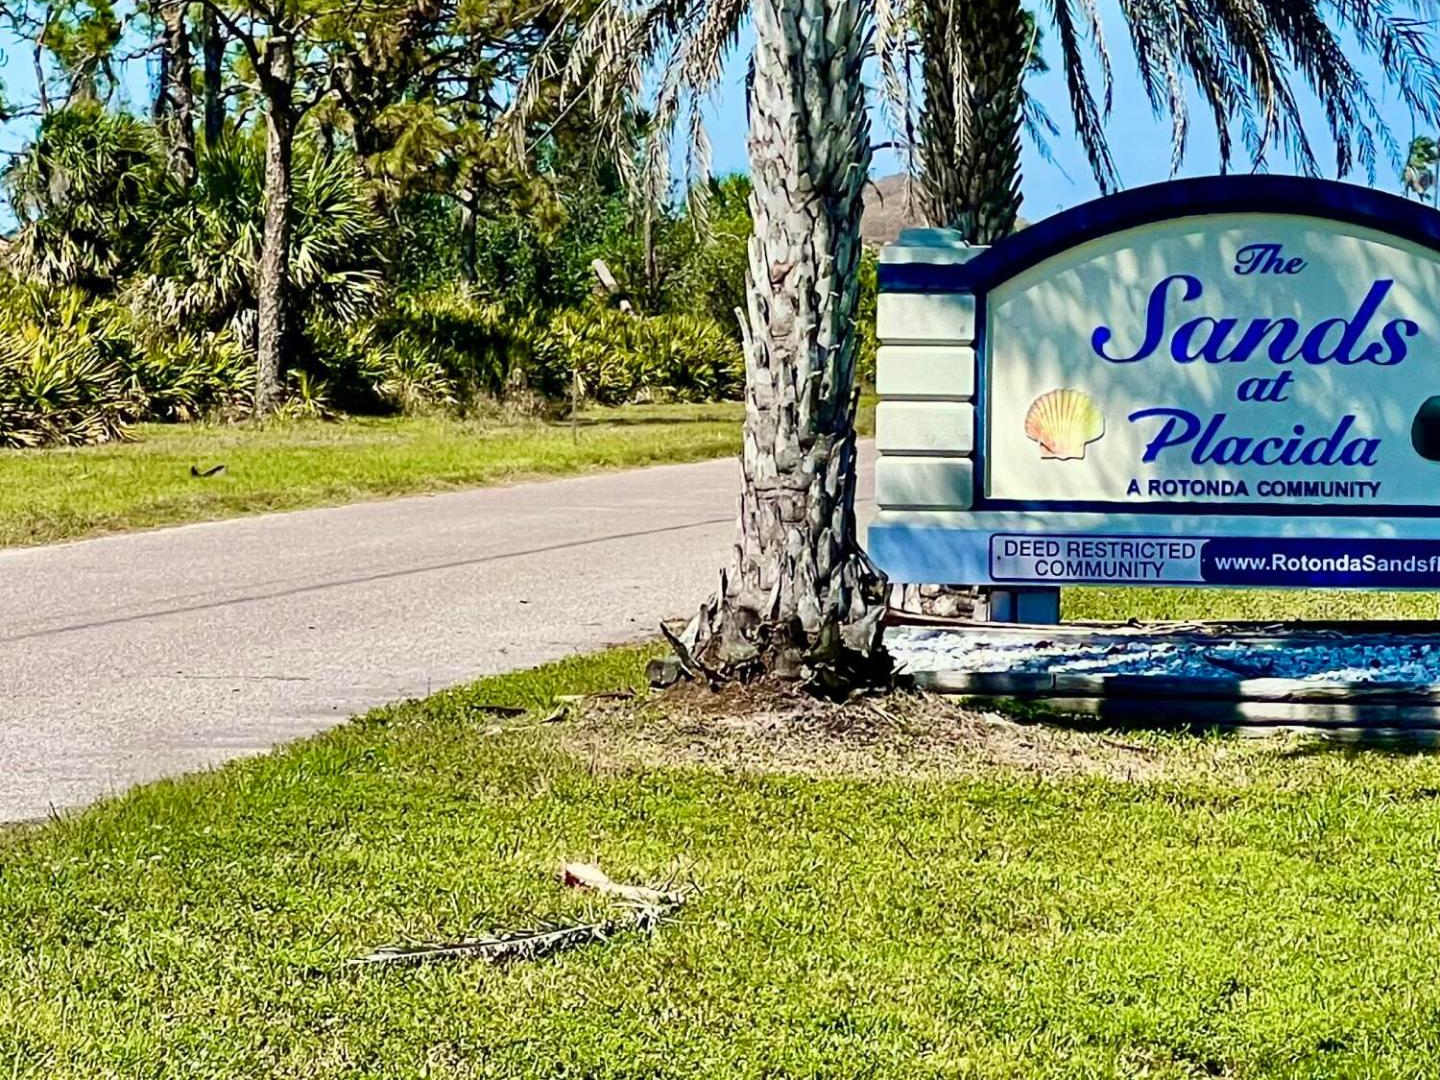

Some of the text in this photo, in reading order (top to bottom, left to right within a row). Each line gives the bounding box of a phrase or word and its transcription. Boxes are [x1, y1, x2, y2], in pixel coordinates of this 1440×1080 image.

[1233, 243, 1308, 275] The
[1091, 275, 1419, 366] Sands
[1236, 370, 1294, 402] at
[1127, 407, 1382, 466] Placida
[1126, 479, 1382, 498] A ROTONDA COMMUNITY
[1004, 540, 1196, 559] DEED RESTRICTED
[1034, 560, 1165, 578] COMMUNITY
